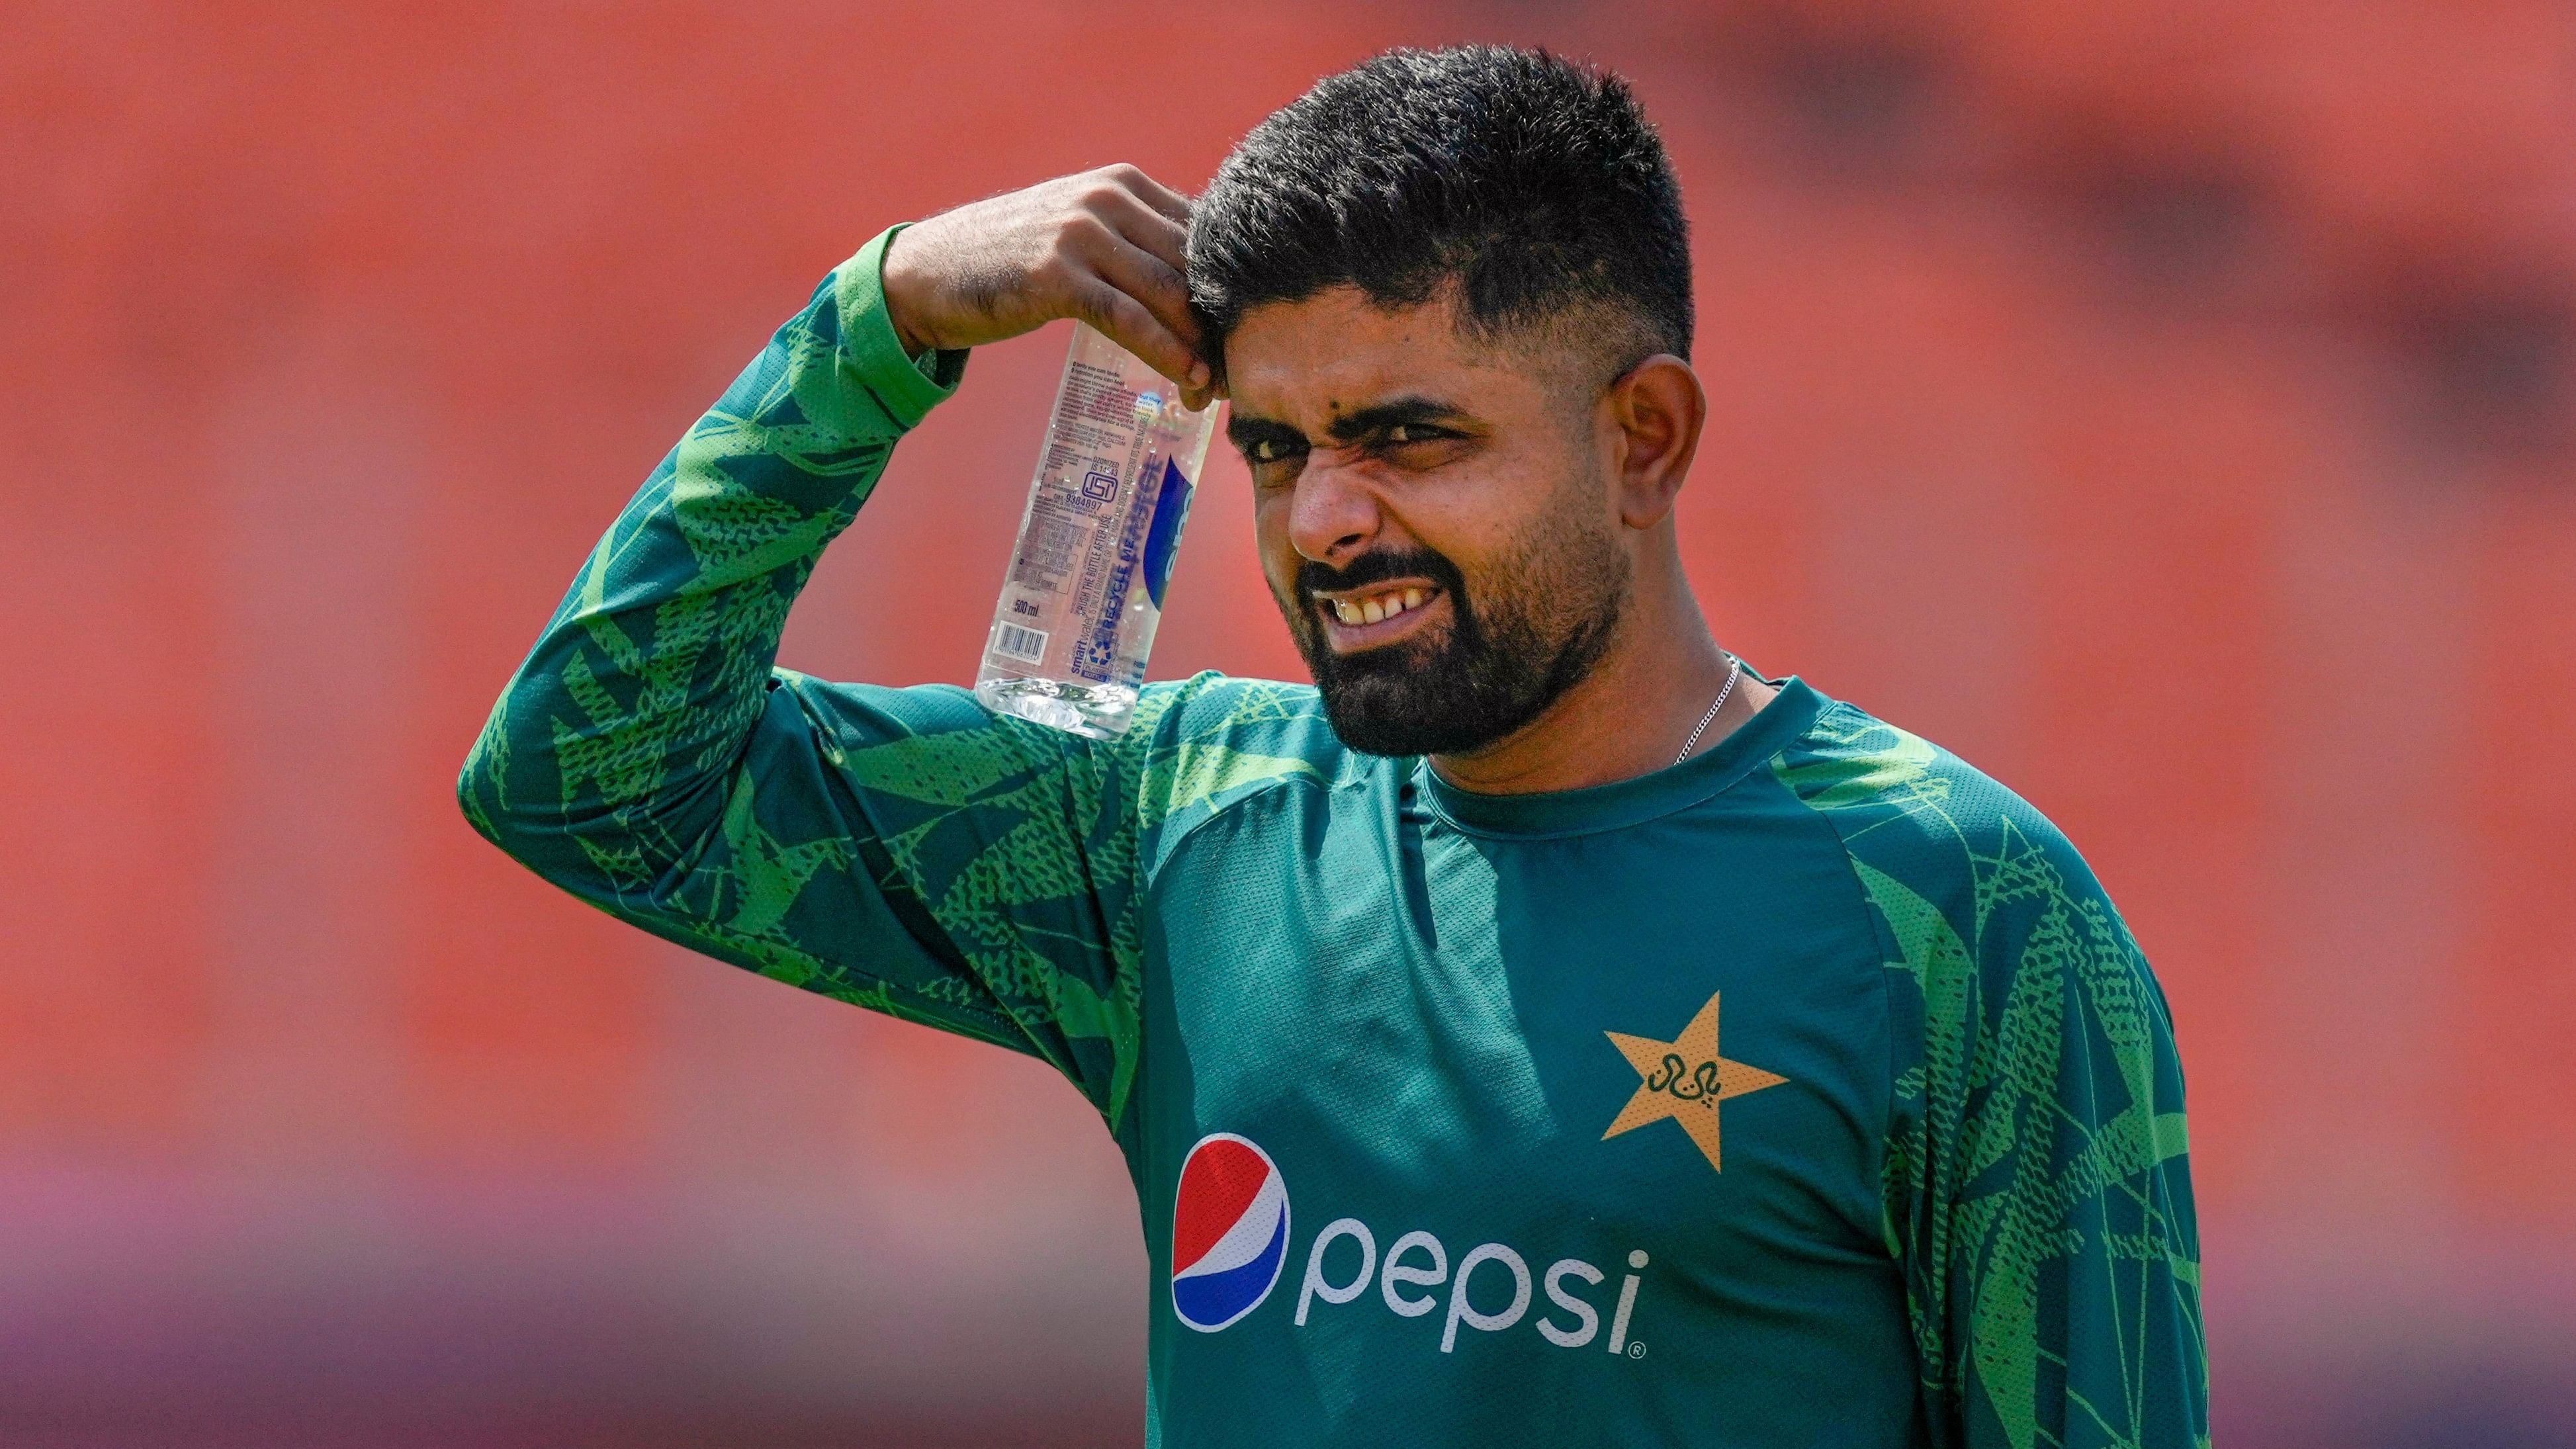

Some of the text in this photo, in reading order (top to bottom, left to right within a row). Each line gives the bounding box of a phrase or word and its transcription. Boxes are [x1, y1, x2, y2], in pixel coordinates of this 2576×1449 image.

[1090, 462, 1098, 471] IS
[1093, 456, 1120, 468] OZONIZED
[1100, 513, 1112, 529] USE
[1094, 529, 1108, 551] AFTER
[1087, 550, 1102, 578] BOTTLE
[1083, 576, 1094, 592] THE
[1076, 592, 1087, 617] CRUSH
[1102, 564, 1128, 629] RECYCLE
[1014, 599, 1040, 617] 500 ml
[1294, 1217, 1649, 1354] pepsi
